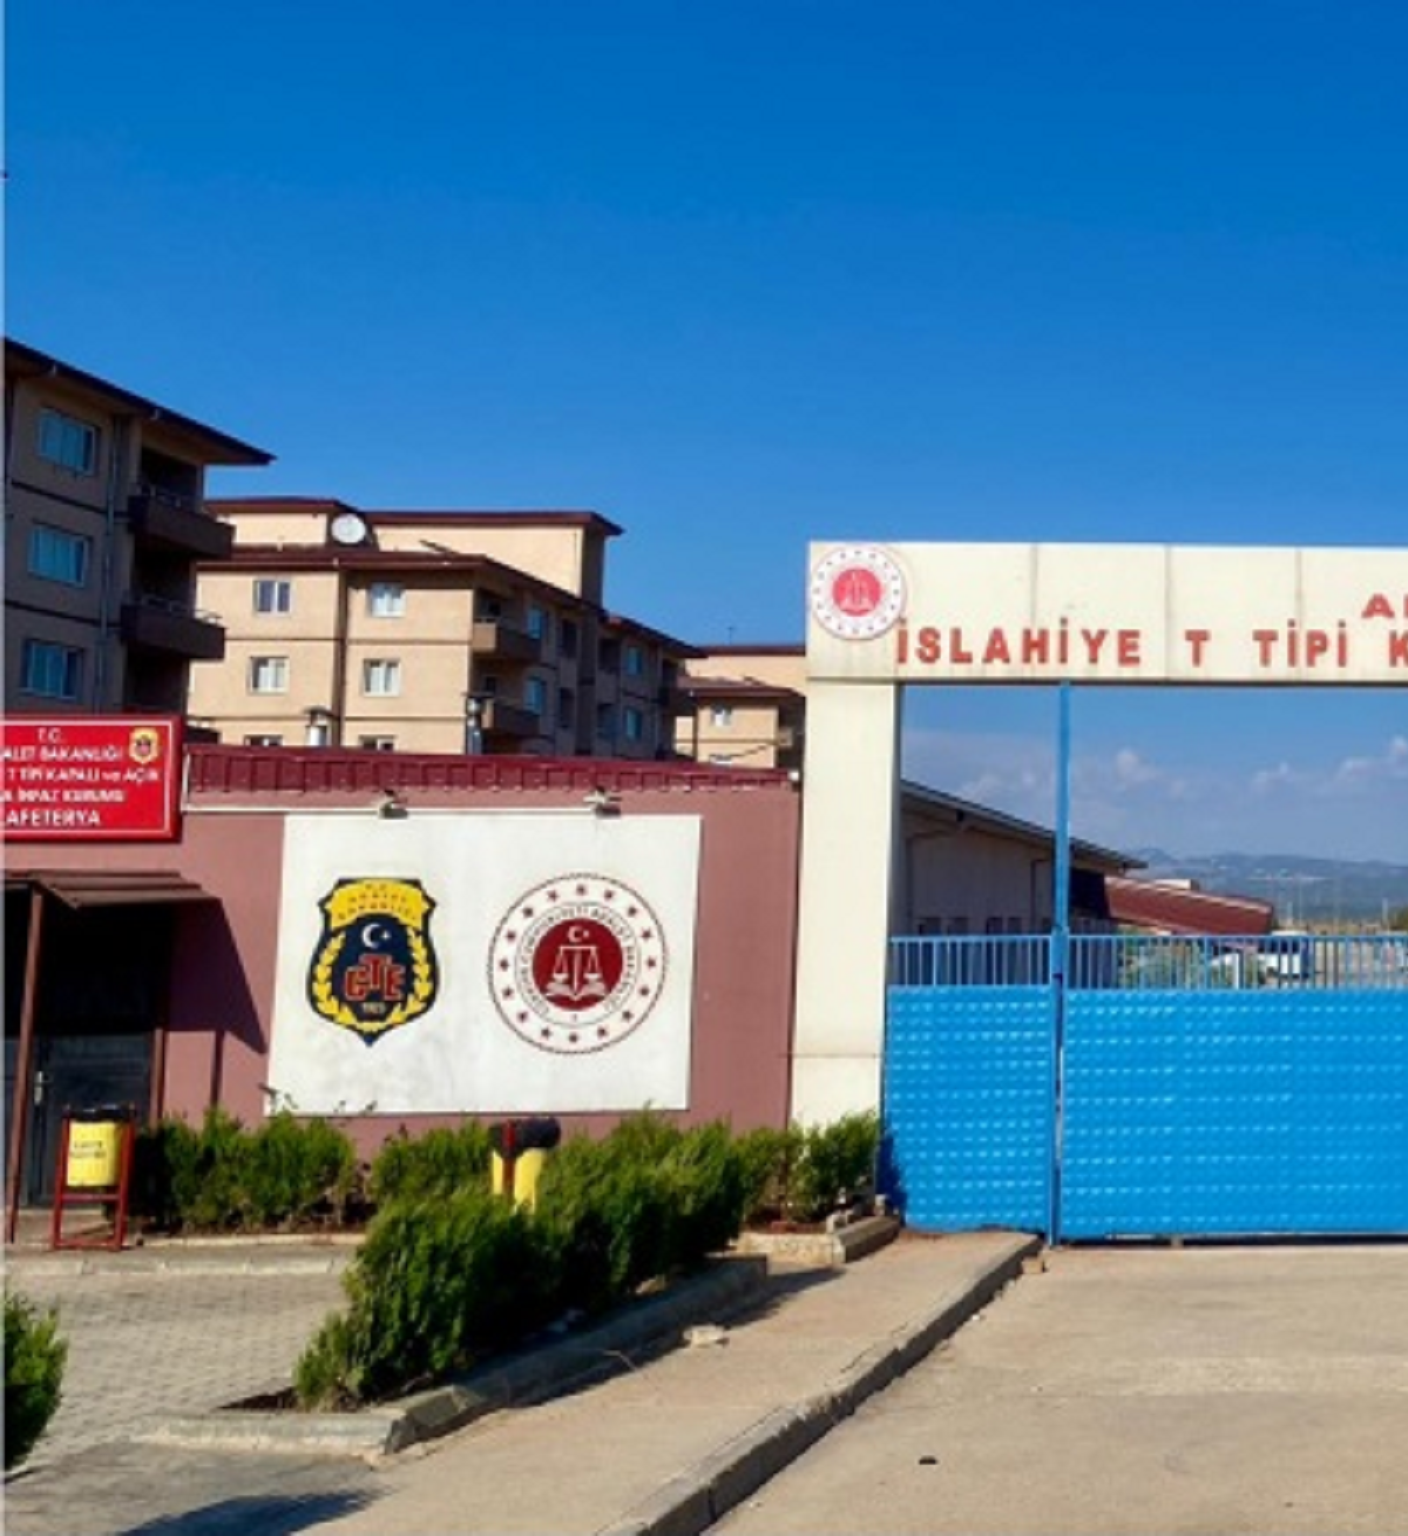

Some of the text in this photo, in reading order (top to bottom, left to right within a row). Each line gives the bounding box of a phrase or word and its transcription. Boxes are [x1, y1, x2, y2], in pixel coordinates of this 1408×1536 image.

[896, 617, 1142, 667] İSLAHİYE
[1184, 630, 1210, 667] T
[1253, 618, 1349, 668] TİPİ
[345, 954, 405, 1000] CTE
